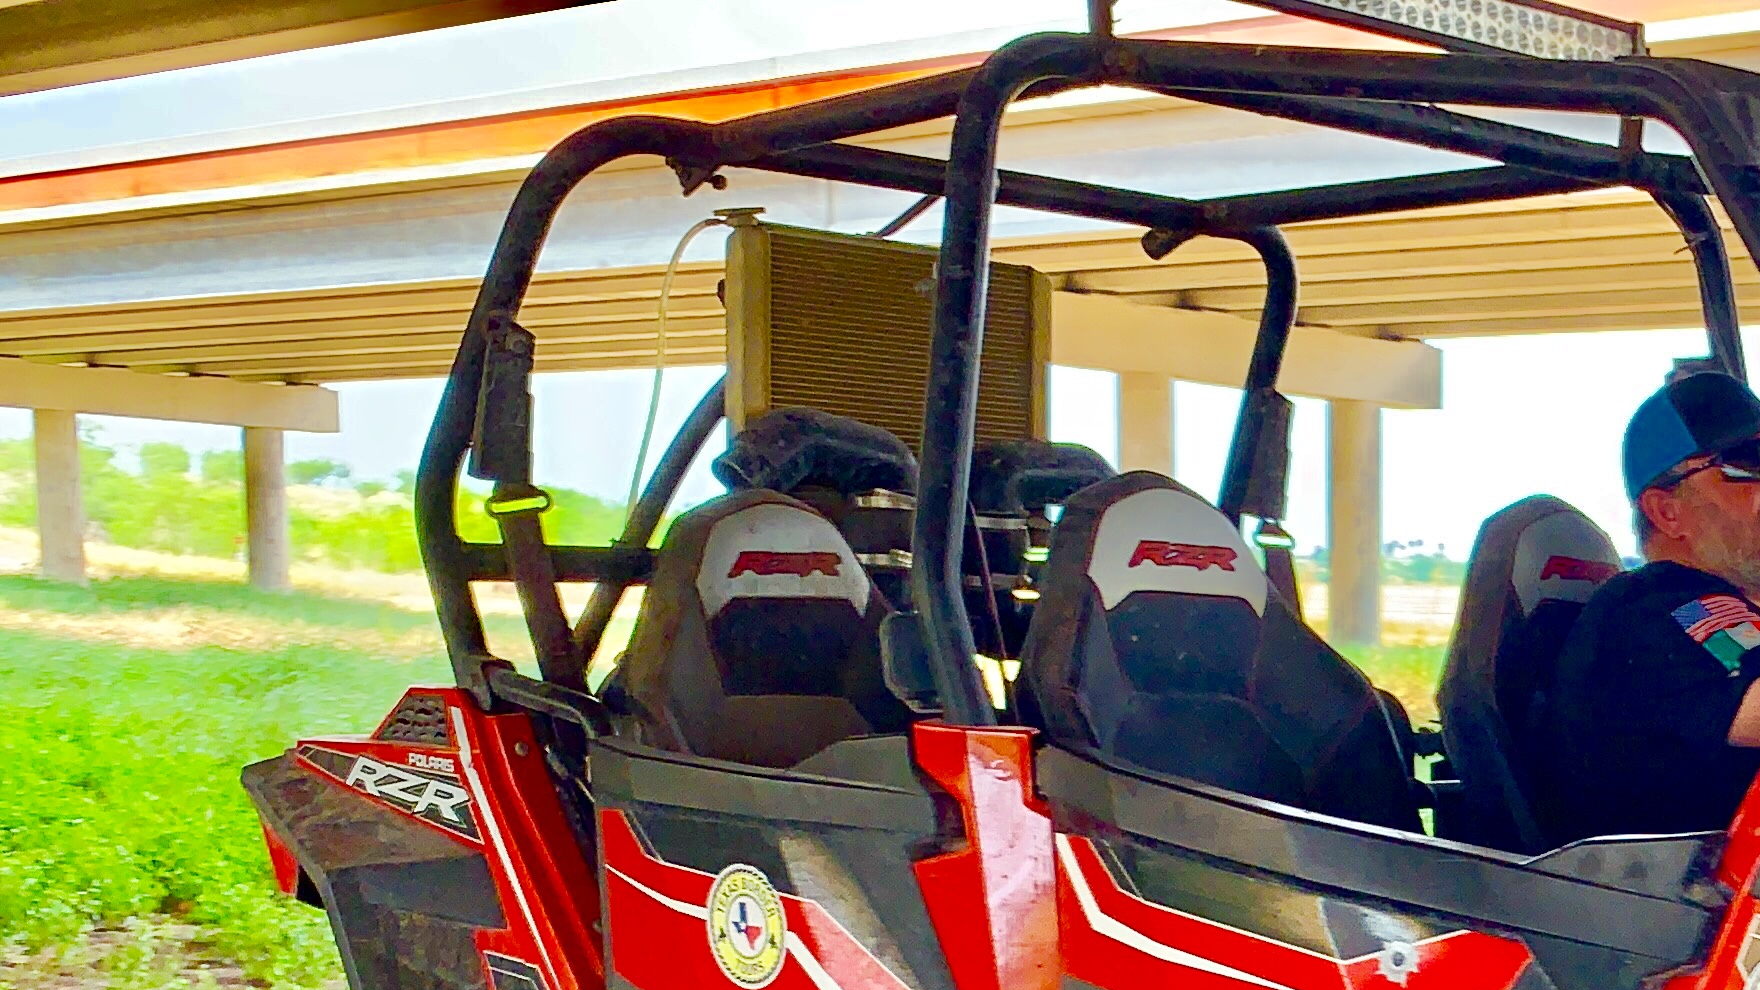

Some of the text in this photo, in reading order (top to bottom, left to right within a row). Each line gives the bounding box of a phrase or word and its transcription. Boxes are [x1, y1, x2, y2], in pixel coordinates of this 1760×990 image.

[727, 551, 841, 578] RZR
[1128, 540, 1237, 571] RZR
[408, 752, 455, 773] POLARIS
[346, 756, 470, 822] RZR
